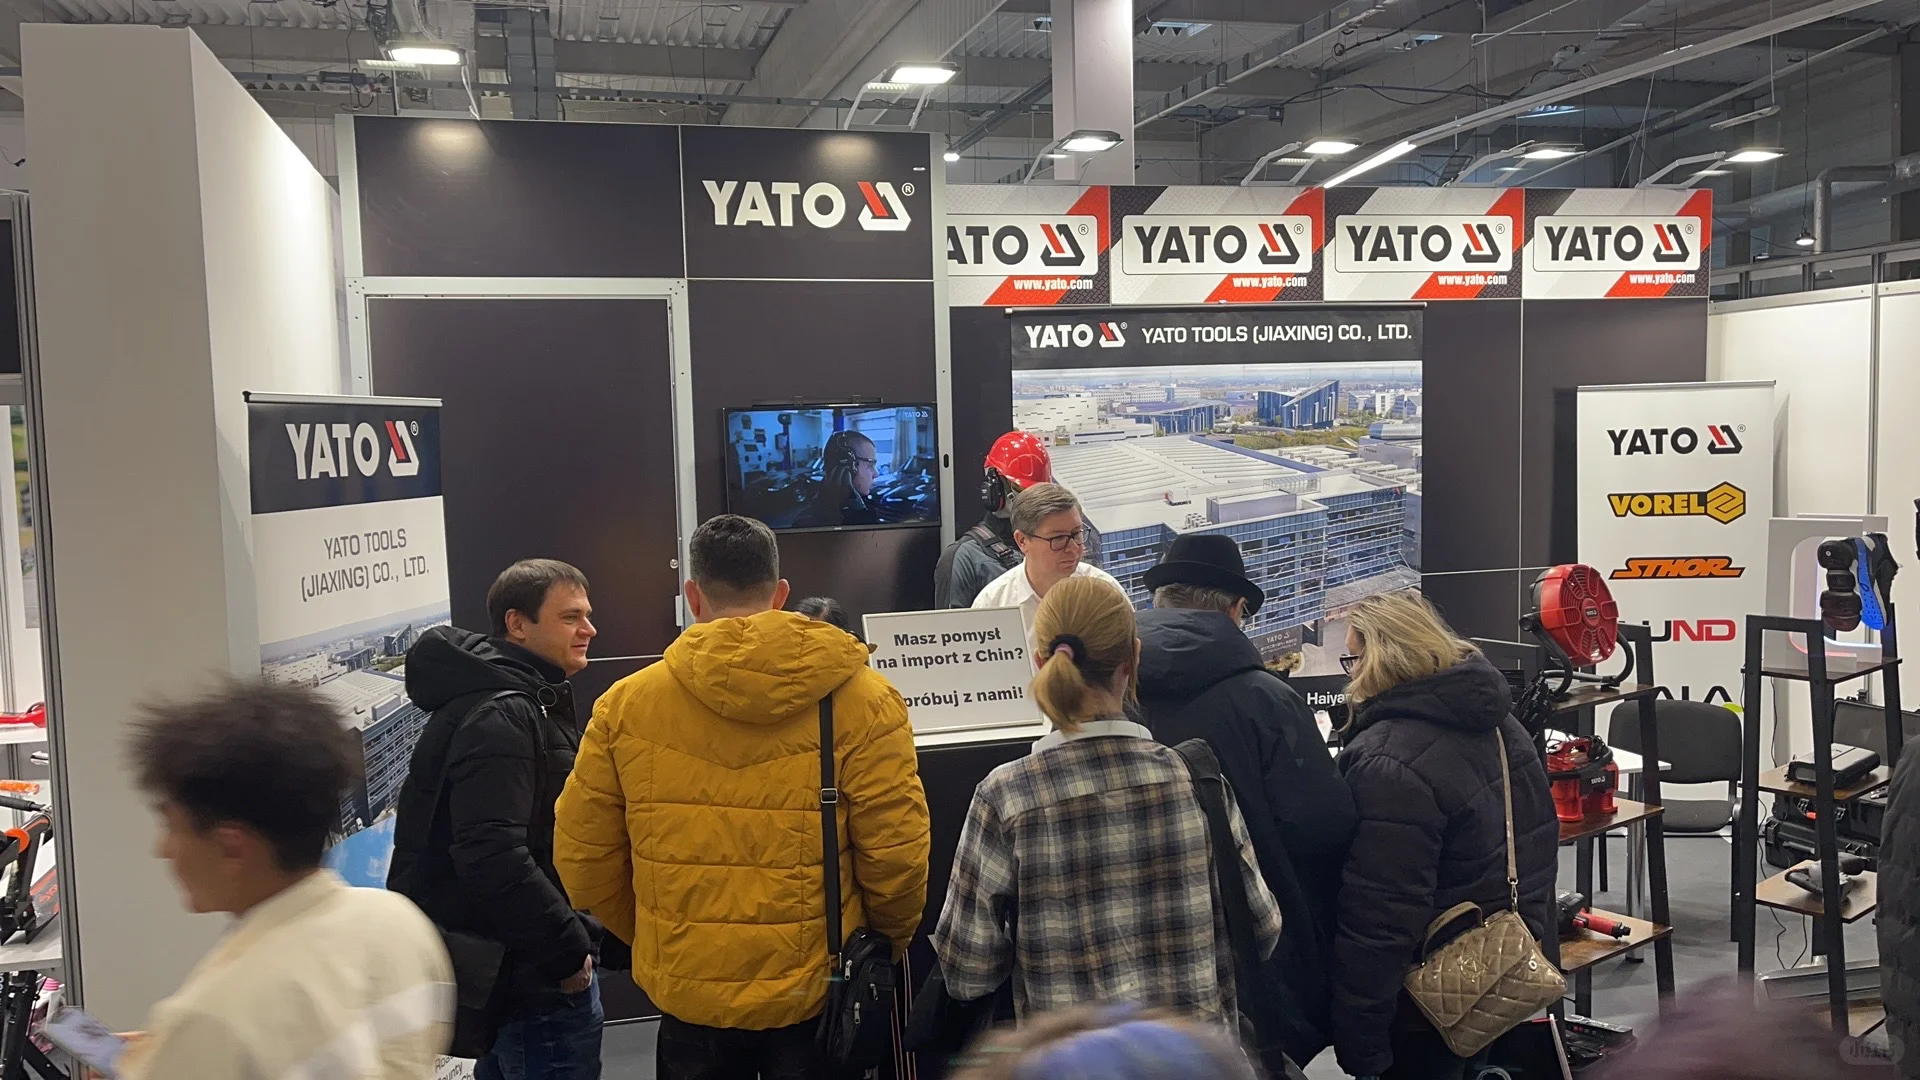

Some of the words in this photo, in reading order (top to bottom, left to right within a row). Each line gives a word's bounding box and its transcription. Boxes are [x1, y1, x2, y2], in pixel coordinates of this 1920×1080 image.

[702, 180, 846, 229] YATO
[947, 225, 1029, 265] ATO
[1133, 225, 1247, 264] YATO
[1346, 225, 1452, 262] YATO
[1544, 225, 1643, 262] YATO
[1014, 278, 1093, 291] www.yato.com
[1233, 276, 1307, 288] www.yato.com
[1437, 274, 1507, 286] www.yato.com
[1629, 272, 1695, 285] www.yato.com
[1024, 323, 1094, 348] YATO
[1141, 327, 1187, 344] YATO
[1191, 326, 1248, 343] TOOLS
[1253, 325, 1333, 344] (JIAXING)
[1338, 325, 1372, 342] CO.,
[1378, 324, 1412, 340] LTD.
[285, 422, 380, 480] YATO
[1607, 427, 1698, 456] YATO
[1609, 494, 1706, 516] VOREL
[323, 534, 361, 560] YATO
[363, 527, 407, 553] TOOLS
[301, 565, 370, 602] (JIAXING)
[372, 561, 399, 583] CO.,
[403, 555, 430, 577] LTD.
[1611, 558, 1743, 578] STHOR
[894, 633, 937, 646] Masz
[941, 627, 1001, 646] pomysł
[1618, 619, 1736, 641] UND
[876, 657, 898, 669] na
[902, 652, 959, 669] import
[963, 652, 972, 663] z
[975, 647, 1024, 663] Chin?
[904, 690, 959, 708] próbuj
[963, 692, 972, 703] z
[977, 686, 1024, 702] nami!
